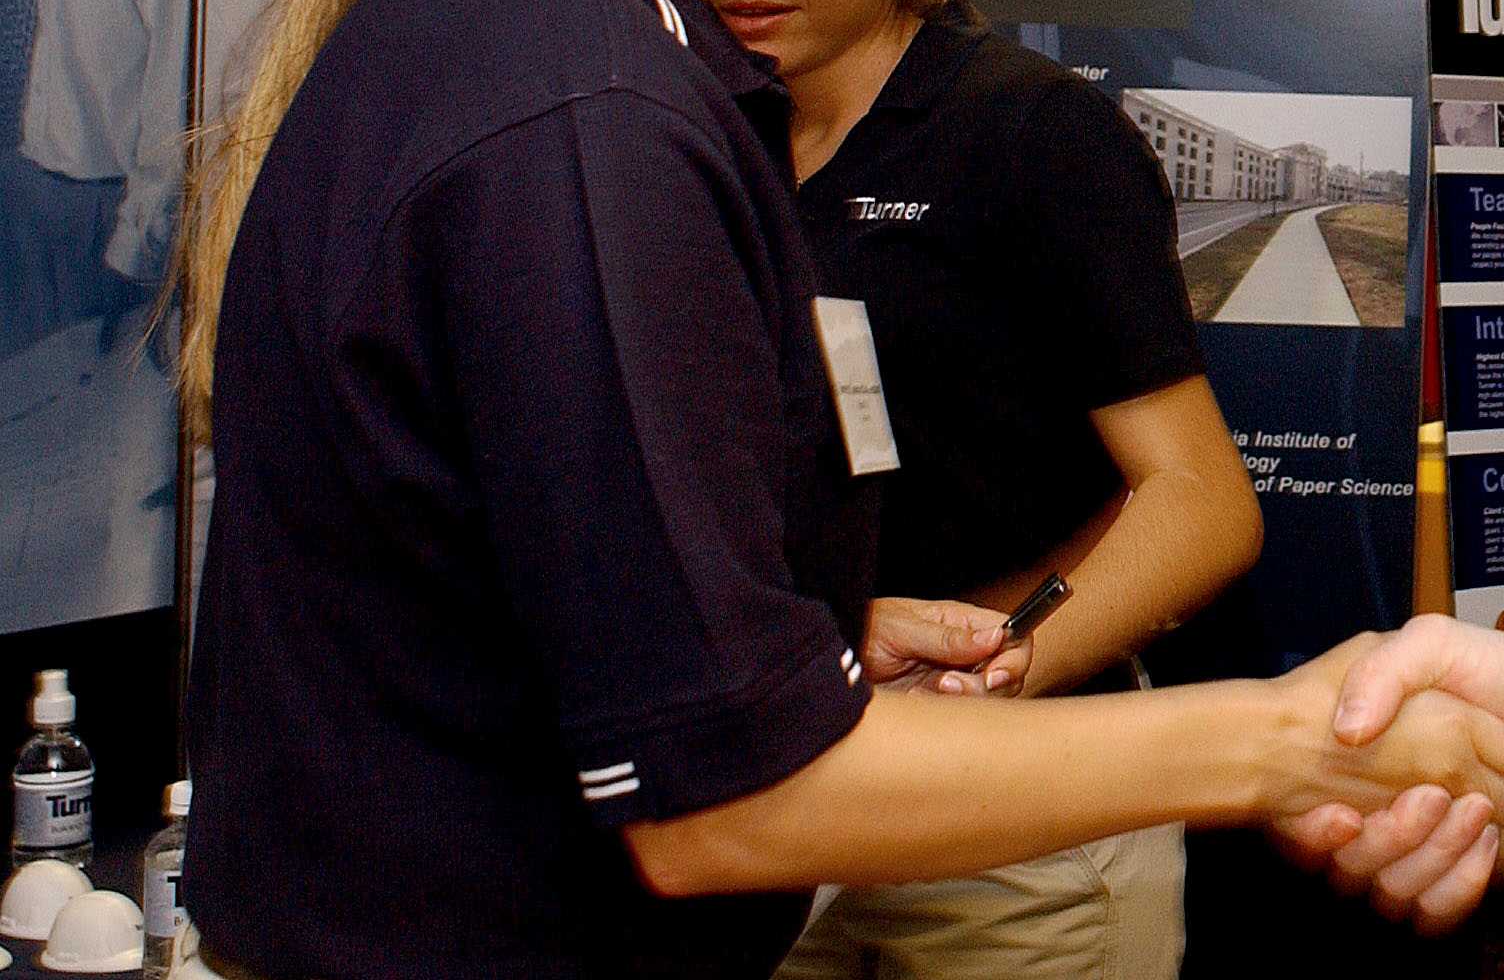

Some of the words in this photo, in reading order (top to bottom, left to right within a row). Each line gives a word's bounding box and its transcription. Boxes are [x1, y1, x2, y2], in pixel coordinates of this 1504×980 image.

[853, 196, 931, 221] Turner
[1254, 431, 1331, 449] Institute
[1336, 433, 1357, 449] of
[1255, 476, 1275, 493] of
[1278, 476, 1336, 497] Paper
[1340, 478, 1415, 496] Science
